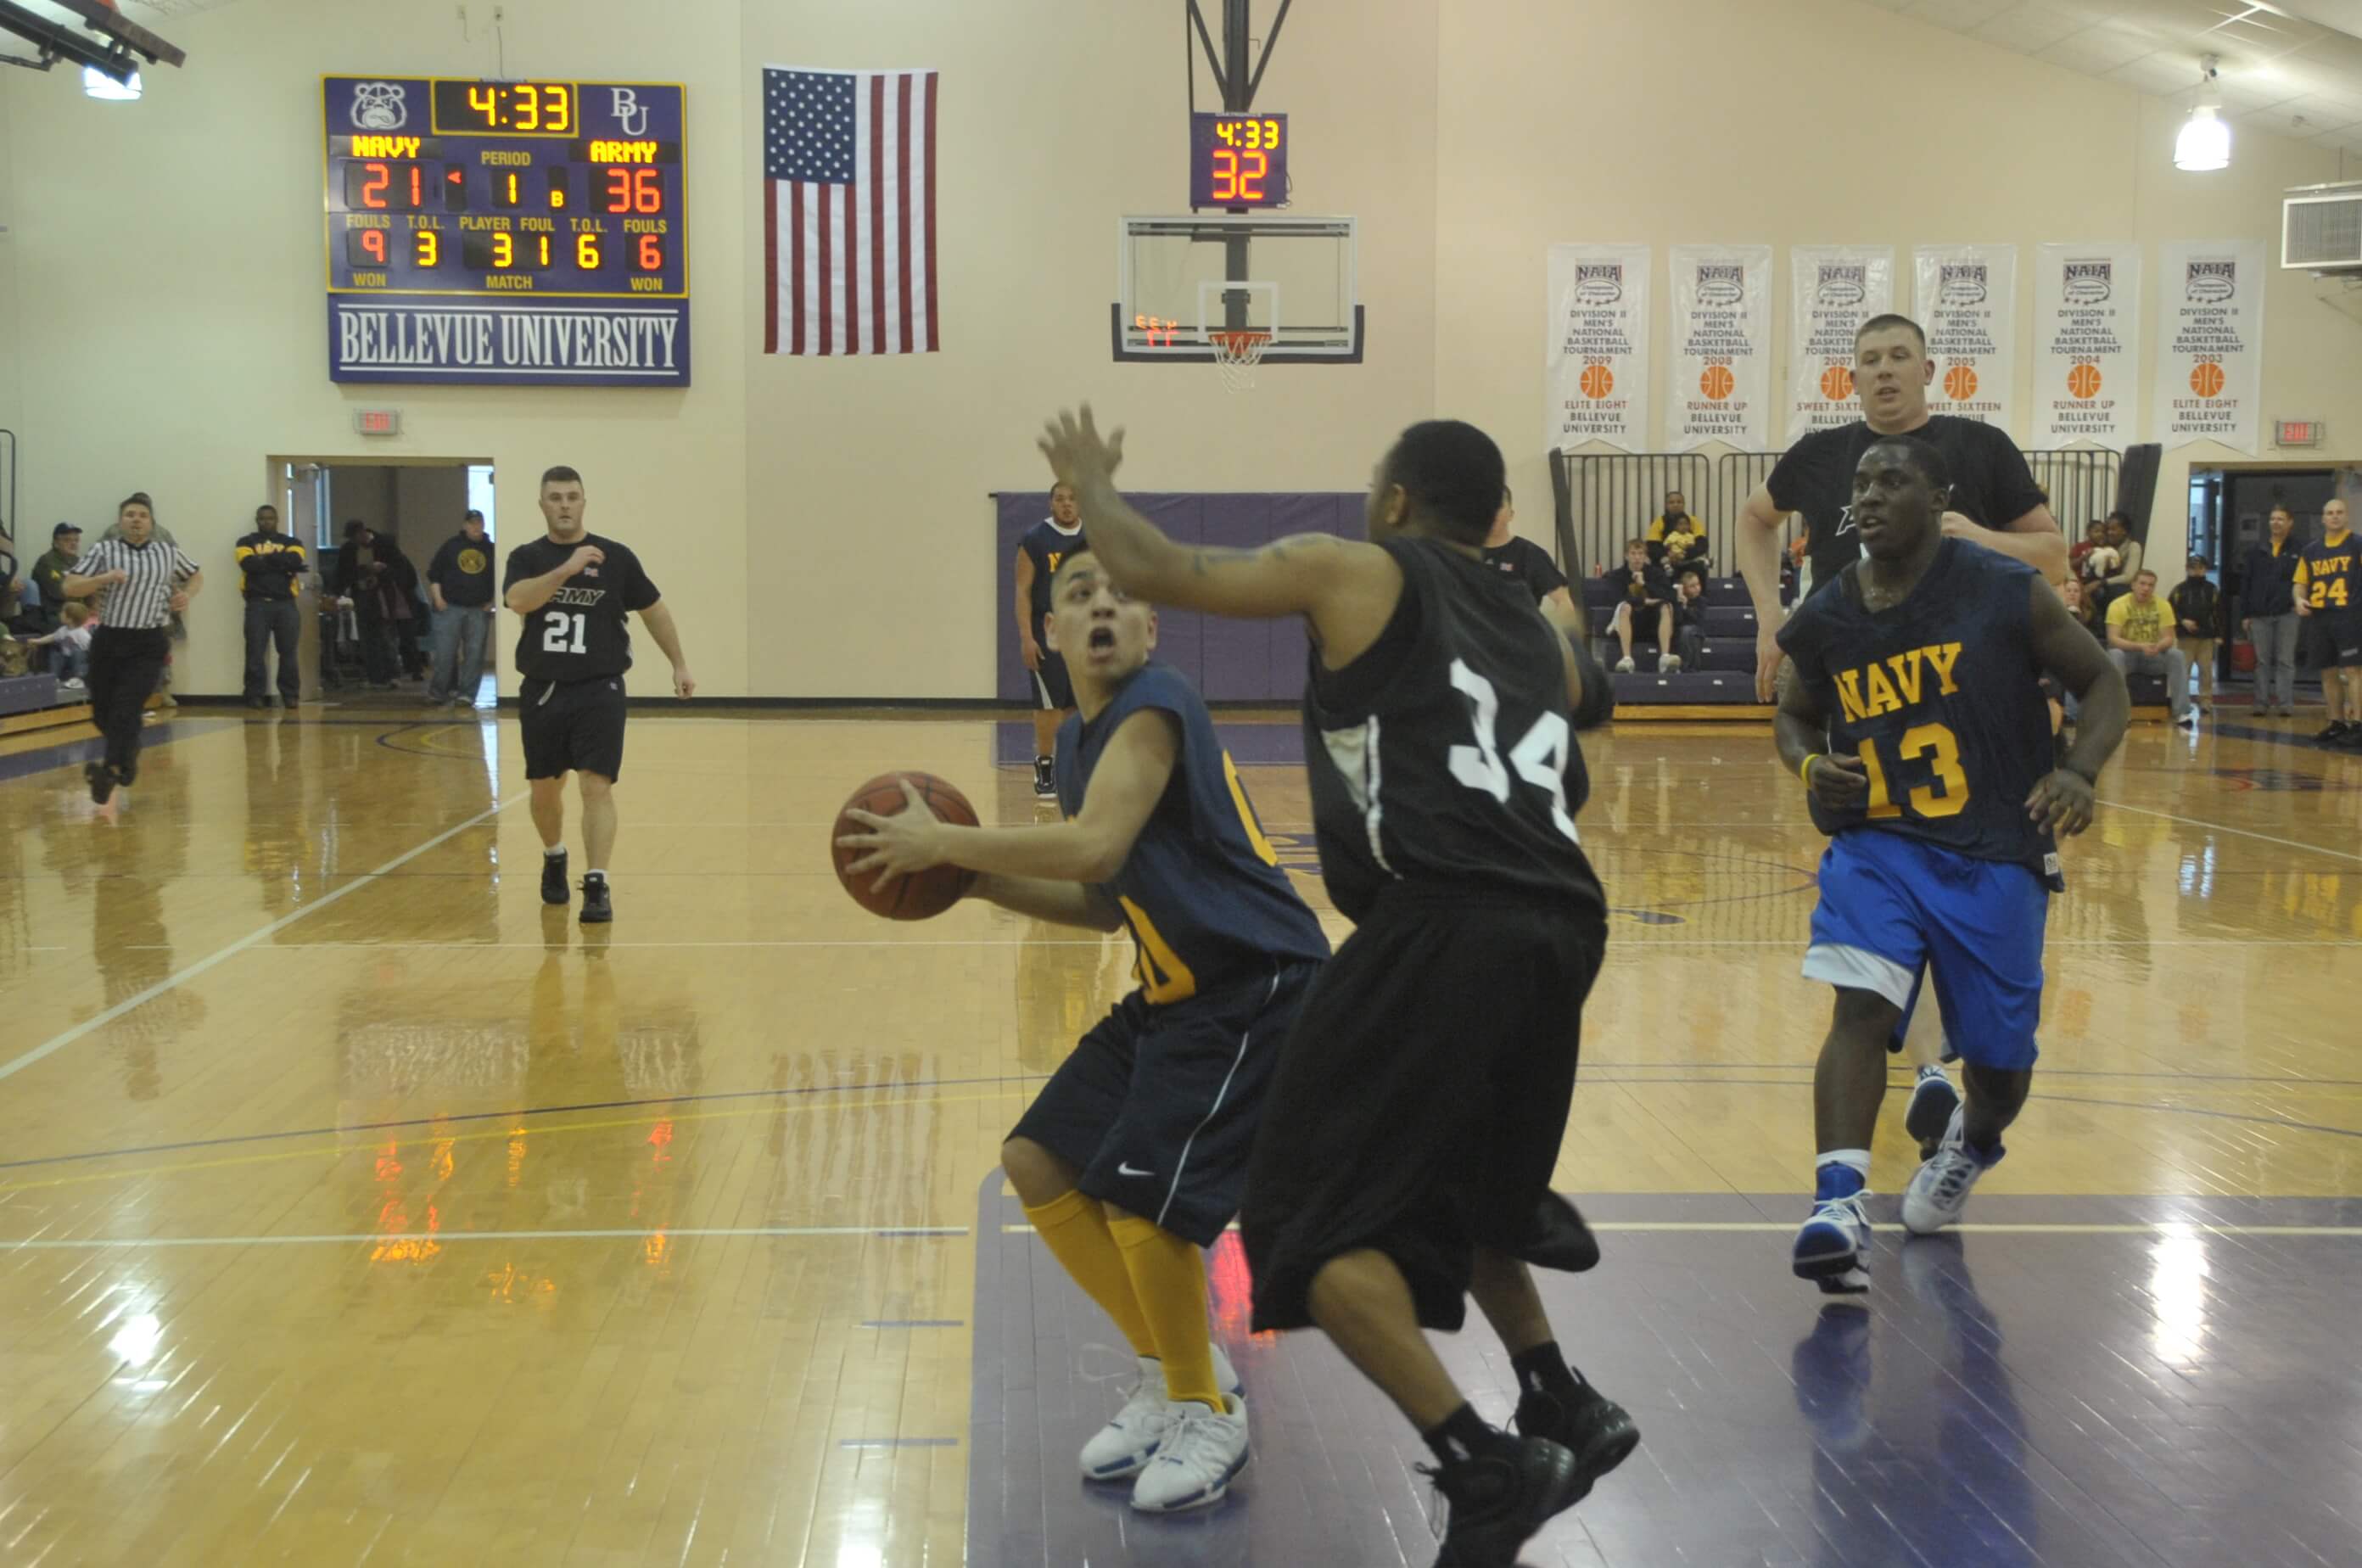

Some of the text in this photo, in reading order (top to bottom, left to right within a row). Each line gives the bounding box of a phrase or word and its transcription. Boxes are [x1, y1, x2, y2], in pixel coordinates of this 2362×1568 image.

[469, 86, 569, 131] 4:33
[1216, 120, 1279, 149] 4:33
[352, 136, 421, 158] NAVY
[590, 140, 658, 163] ARMY
[481, 151, 531, 166] PERIOD
[1212, 149, 1268, 199] 32
[507, 173, 517, 204] 1
[607, 168, 661, 213] 36
[345, 215, 390, 229] FOULS
[407, 215, 445, 230] T.O.L.
[460, 216, 555, 232] PLAYER FOUL
[571, 218, 607, 232] T.O.L.
[624, 220, 668, 234] FOULS
[362, 229, 384, 262] 9
[417, 231, 437, 266] 3
[577, 234, 600, 269] 6
[639, 235, 662, 270] 6
[1578, 266, 1619, 282] NAIA
[1700, 267, 1741, 283] NAIA
[2066, 265, 2109, 281] NAIA
[2189, 264, 2232, 279] NAIA
[353, 273, 386, 287] WON
[486, 275, 533, 289] MATCH
[630, 277, 663, 292] WON
[1693, 329, 1744, 338] NATIONAL
[1815, 328, 1855, 337] NATION
[2182, 326, 2236, 334] NATIONAL
[339, 311, 679, 367] BELLEVUE UNIVERSITY
[1567, 337, 1629, 345] BASKETBALL
[1564, 346, 1632, 355] TOURNAMENT
[2051, 345, 2121, 354] TOURNAMENT
[2172, 344, 2245, 353] TOURNAMENT
[1583, 356, 1612, 365] 2009
[1564, 400, 1627, 409] ELITE EIGHT
[1687, 401, 1748, 411] RUNNER UP
[1797, 402, 1830, 412] SWEET
[1927, 402, 2001, 412] WEET SIXTEEN
[2052, 400, 2115, 409] RUNNER UP
[2173, 400, 2238, 408] ELITE EIGHT
[1570, 412, 1620, 422] BELLEVUE
[1690, 413, 1742, 423] BELLEVUE
[2058, 412, 2110, 422] BELLEVUE
[2179, 412, 2231, 421] BELLEVUE
[1563, 424, 1626, 434] UNIVERSITY
[1683, 425, 1747, 434] UNIVERSITY
[2051, 424, 2116, 434] UNIVERSITY
[2172, 423, 2236, 433] UNIVERSITY
[2311, 556, 2352, 576] NAVY
[550, 586, 606, 607] RMY
[2310, 578, 2348, 608] 24
[544, 611, 586, 654] 21
[1833, 641, 1962, 723] NAVY
[1449, 658, 1578, 845] 34
[1858, 722, 1970, 818] 13
